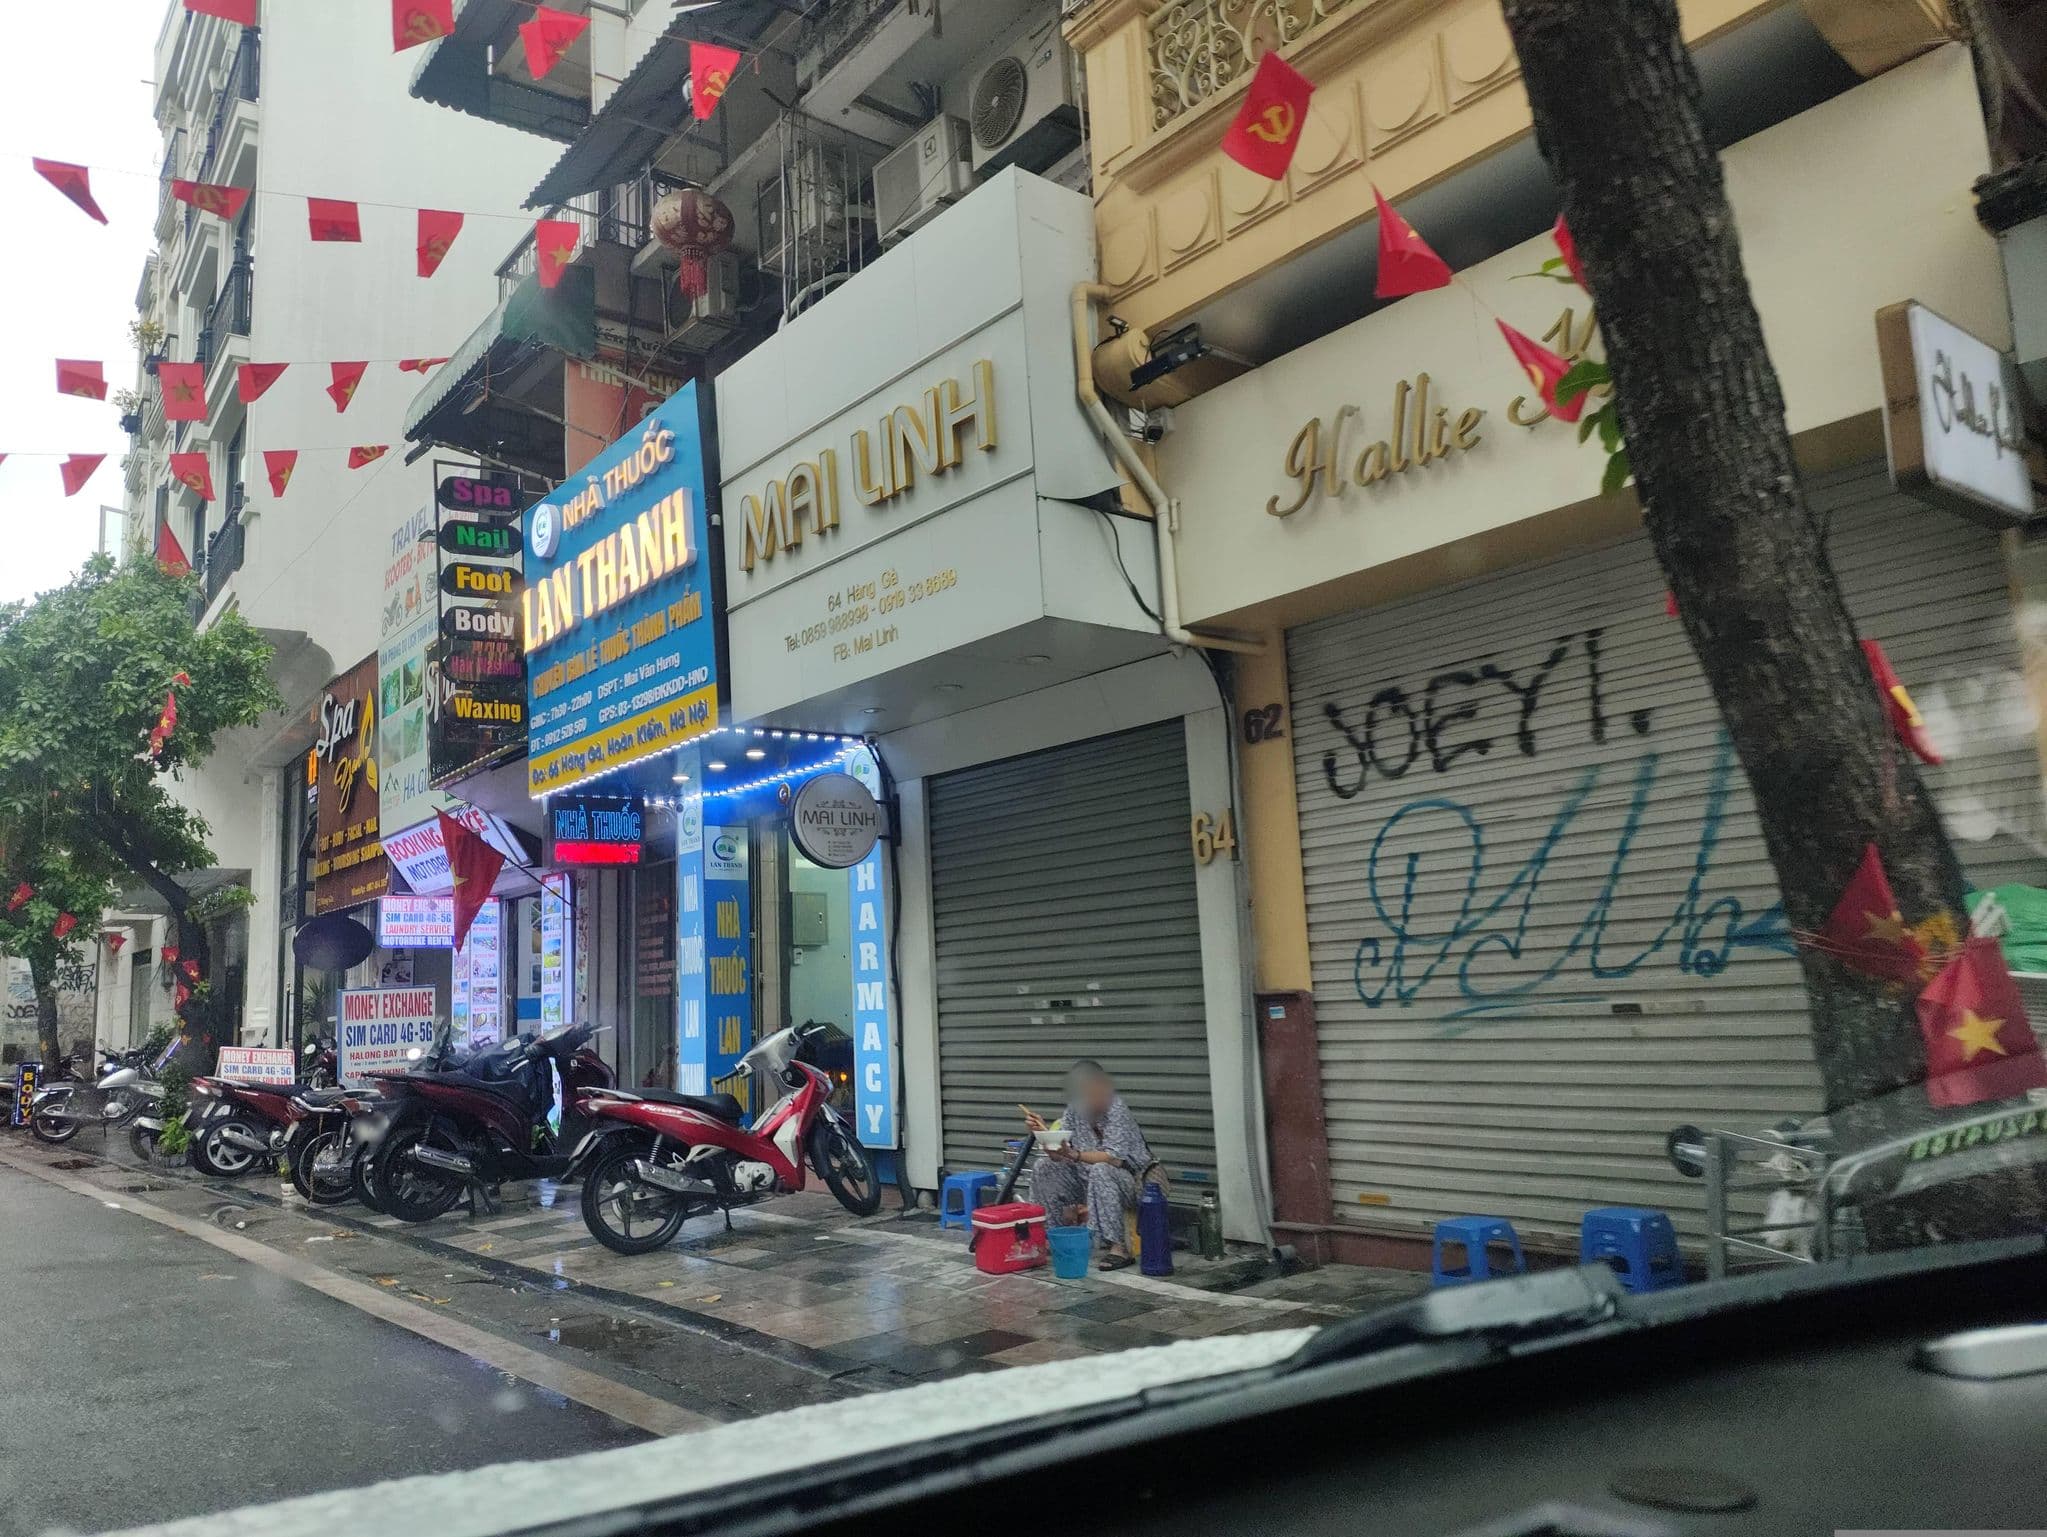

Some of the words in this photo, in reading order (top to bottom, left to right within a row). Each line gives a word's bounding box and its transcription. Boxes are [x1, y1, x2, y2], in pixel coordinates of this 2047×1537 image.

[603, 418, 675, 499] THUỐC
[1266, 372, 1488, 519] Hallie
[739, 448, 840, 573] MAI
[850, 359, 998, 507] LINH
[453, 479, 511, 506] Spa
[456, 525, 509, 548] Nail
[577, 487, 697, 619] THANH
[456, 566, 512, 593] Foot
[828, 592, 841, 611] 64
[455, 609, 514, 637] Body
[455, 697, 521, 724] Waxing
[1243, 703, 1284, 744] 62
[316, 693, 355, 763] Spa
[555, 805, 588, 839] NHÀ
[592, 802, 640, 840] THUỐC
[803, 810, 834, 825] MAI
[840, 811, 876, 827] LINH
[386, 826, 444, 861] BOOKING
[1191, 808, 1235, 864] 64
[385, 912, 400, 922] SIM
[403, 913, 424, 922] CARD
[385, 924, 417, 934] LAUNDRY
[420, 924, 450, 934] SERVICE
[717, 895, 740, 938] NHÀ
[382, 936, 426, 946] MOTORBIKE
[428, 936, 453, 946] RENTAL
[710, 945, 746, 995] THUỐC
[7, 1004, 39, 1018] JOE
[345, 994, 379, 1021] MONEY
[383, 991, 433, 1018] EXCHANGE
[346, 1025, 366, 1047] SIM
[370, 1023, 397, 1045] CARD
[719, 1015, 741, 1055] LAN
[223, 1050, 250, 1063] MONEY
[252, 1051, 292, 1064] EXCHANGE
[350, 1050, 381, 1061] HALONG
[383, 1049, 398, 1058] BAY
[224, 1065, 239, 1074] SIM
[242, 1065, 263, 1075] CARD
